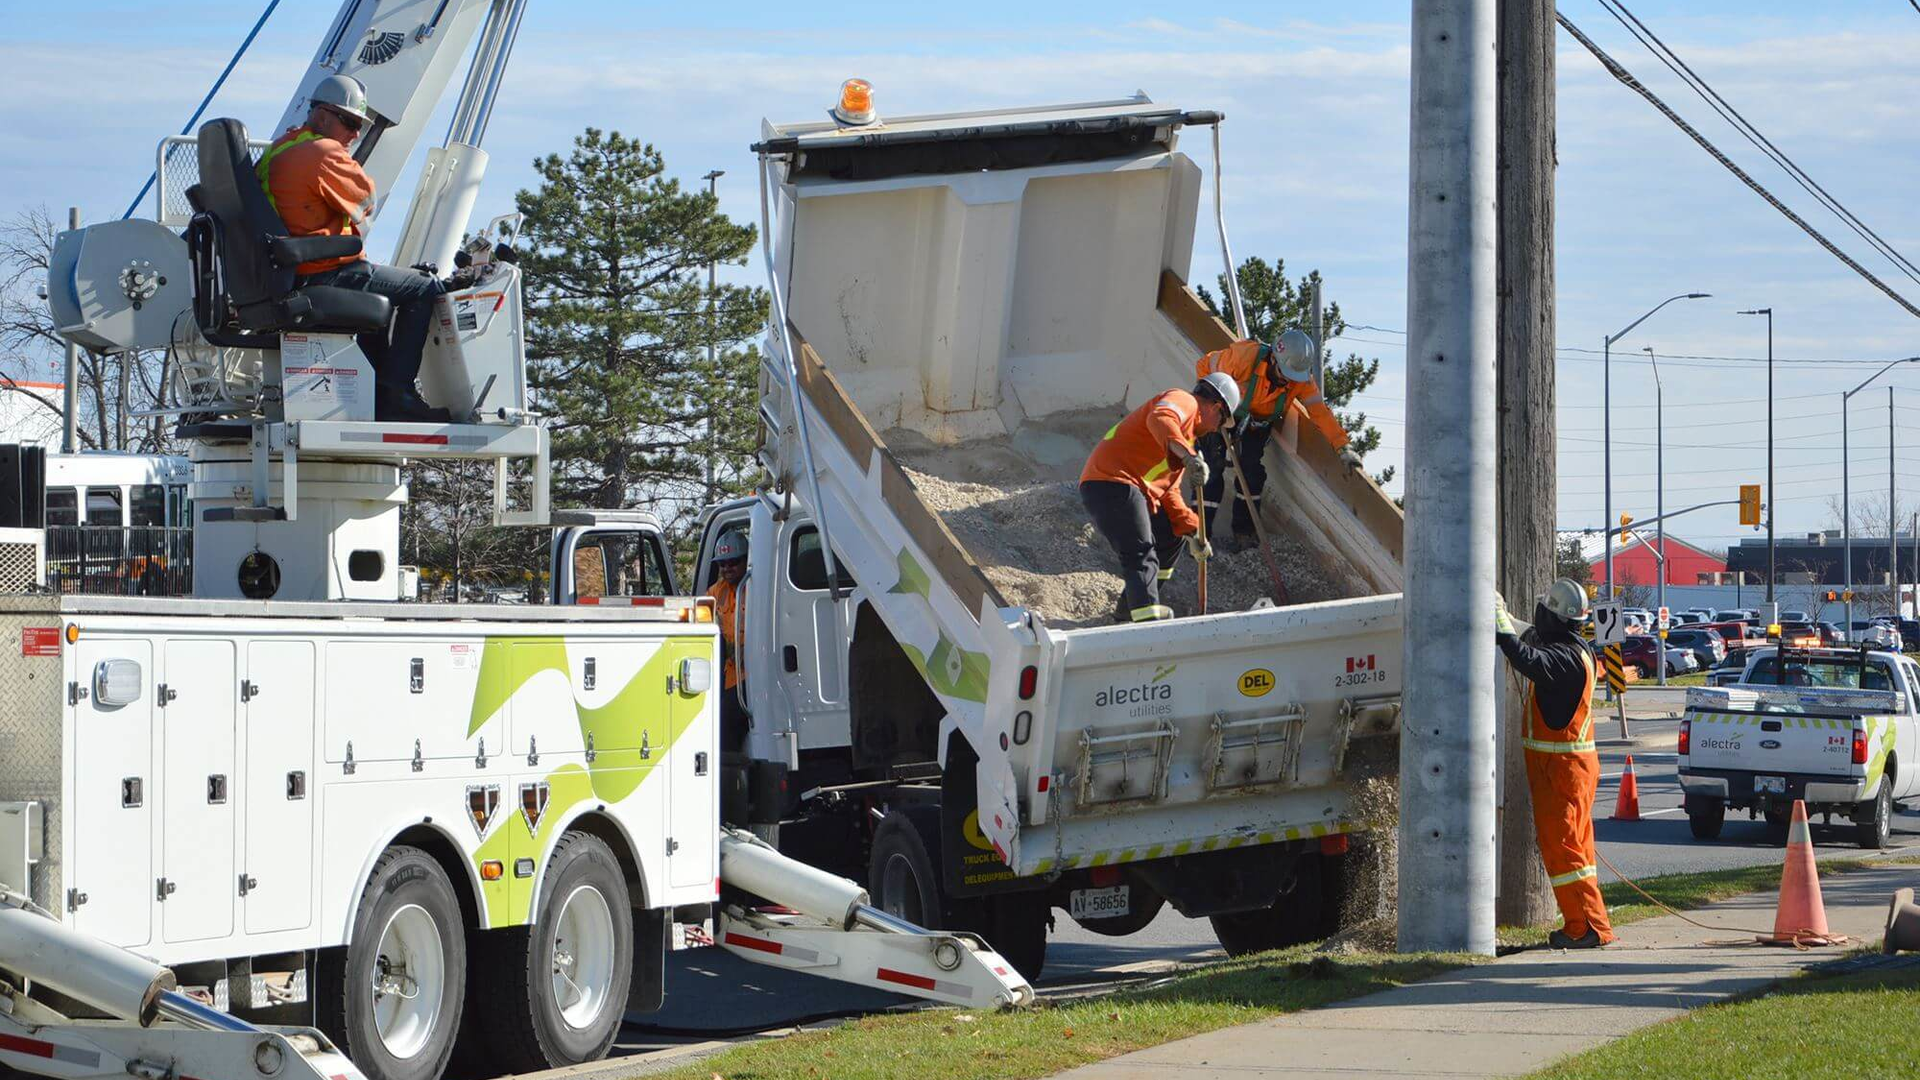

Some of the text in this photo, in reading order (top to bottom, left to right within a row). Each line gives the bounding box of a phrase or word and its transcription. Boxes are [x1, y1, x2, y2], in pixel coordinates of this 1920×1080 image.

[1244, 675, 1270, 688] DEL
[1335, 671, 1385, 687] 2-302-18
[1095, 684, 1172, 707] alectra
[1129, 704, 1172, 718] utilities
[1701, 738, 1741, 750] alectra
[1074, 894, 1127, 913] AV 58656
